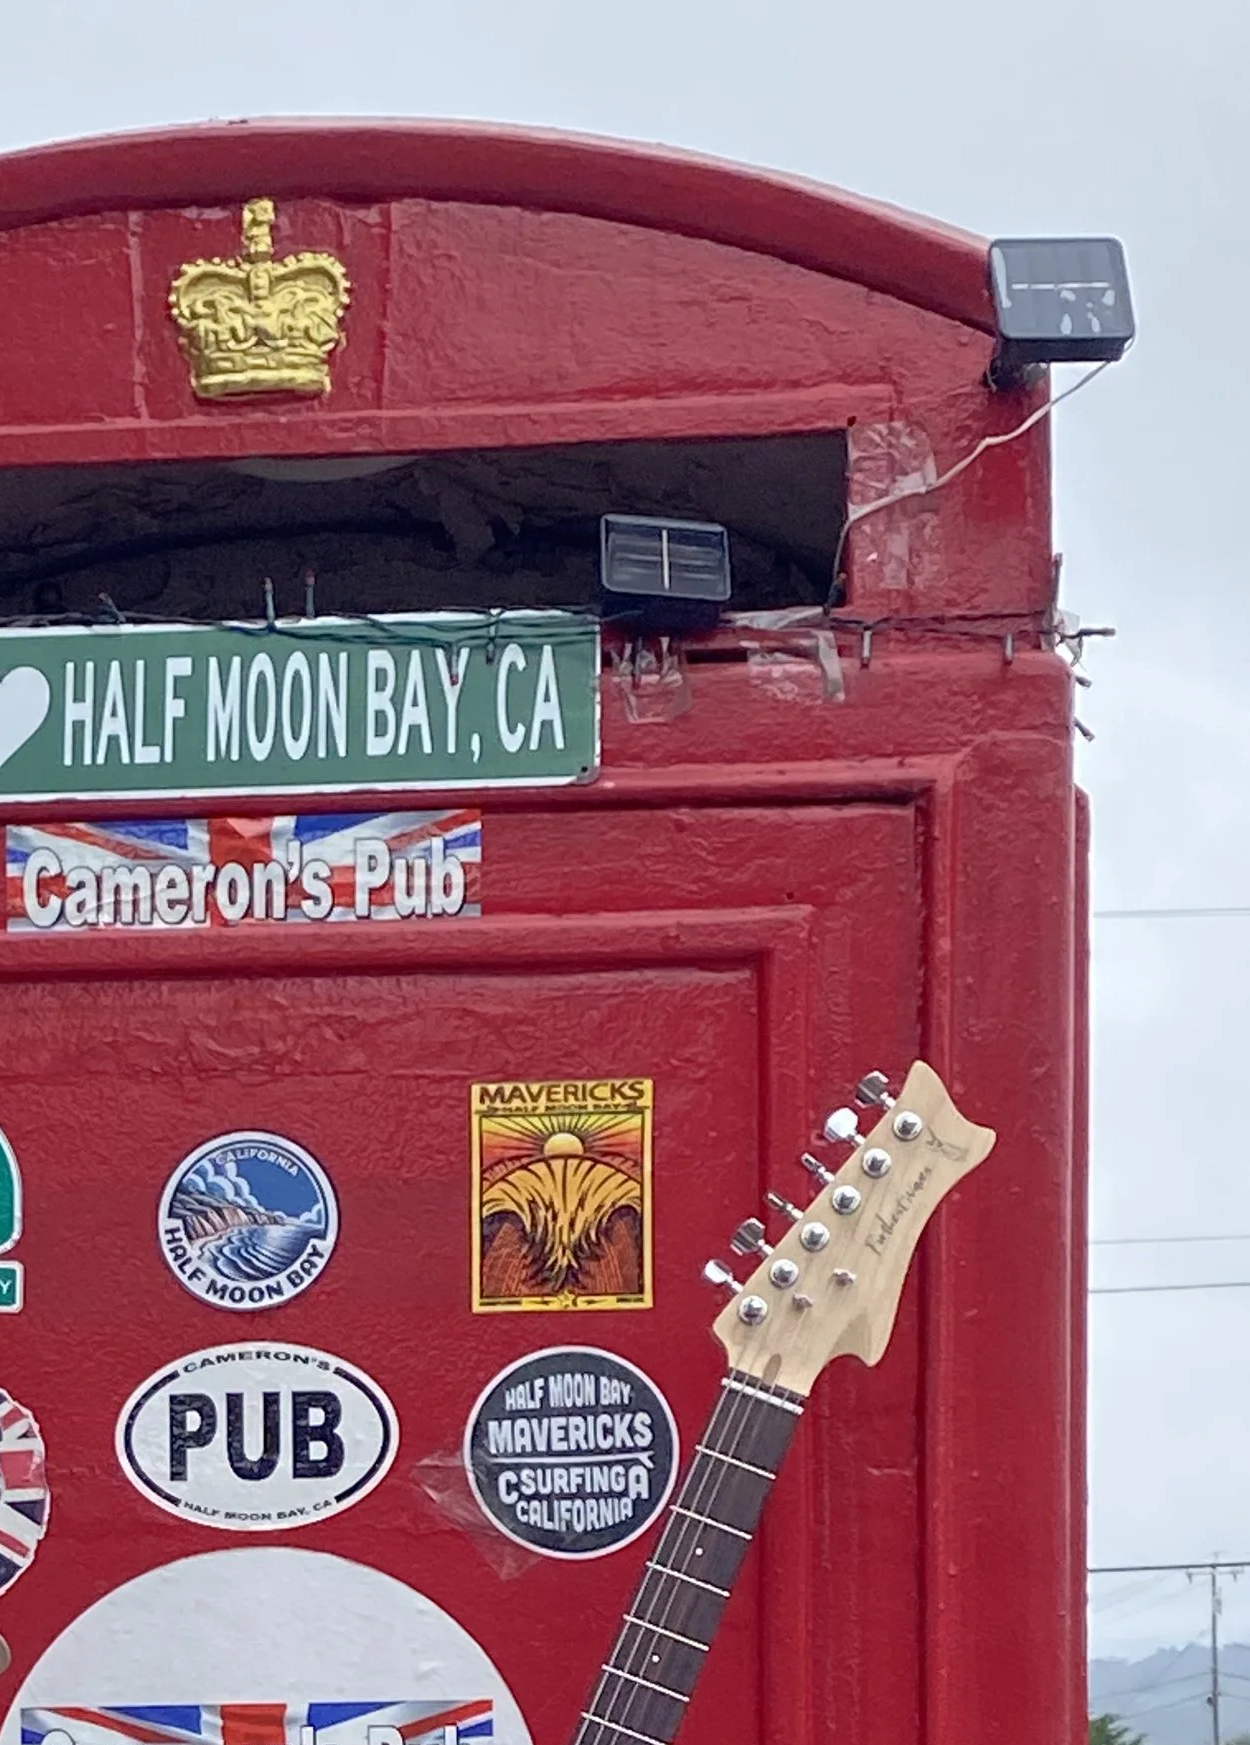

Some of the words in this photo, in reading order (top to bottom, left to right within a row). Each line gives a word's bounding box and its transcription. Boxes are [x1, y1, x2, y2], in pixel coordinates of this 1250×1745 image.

[63, 656, 192, 766] HALF
[206, 651, 348, 763] MOON
[365, 647, 483, 764] BAY,
[496, 643, 566, 753] CA
[21, 839, 334, 928] Cameron's
[352, 837, 466, 919] Pub
[479, 1081, 646, 1105] MAVERICKS
[214, 1149, 301, 1178] CALIFORNIA
[164, 1226, 208, 1282] HALF
[205, 1277, 284, 1304] MOON
[285, 1243, 326, 1289] BAY
[182, 1350, 332, 1374] CAMERON'S
[505, 1378, 545, 1412] HALF
[549, 1373, 597, 1408] MOON
[600, 1376, 632, 1406] BAY
[168, 1390, 345, 1482] PUB
[487, 1411, 654, 1455] MAVERICKS
[184, 1501, 220, 1516] HALF
[224, 1511, 272, 1521] MOON
[312, 1500, 332, 1512] CA
[515, 1498, 634, 1533] CALIFORNIA
